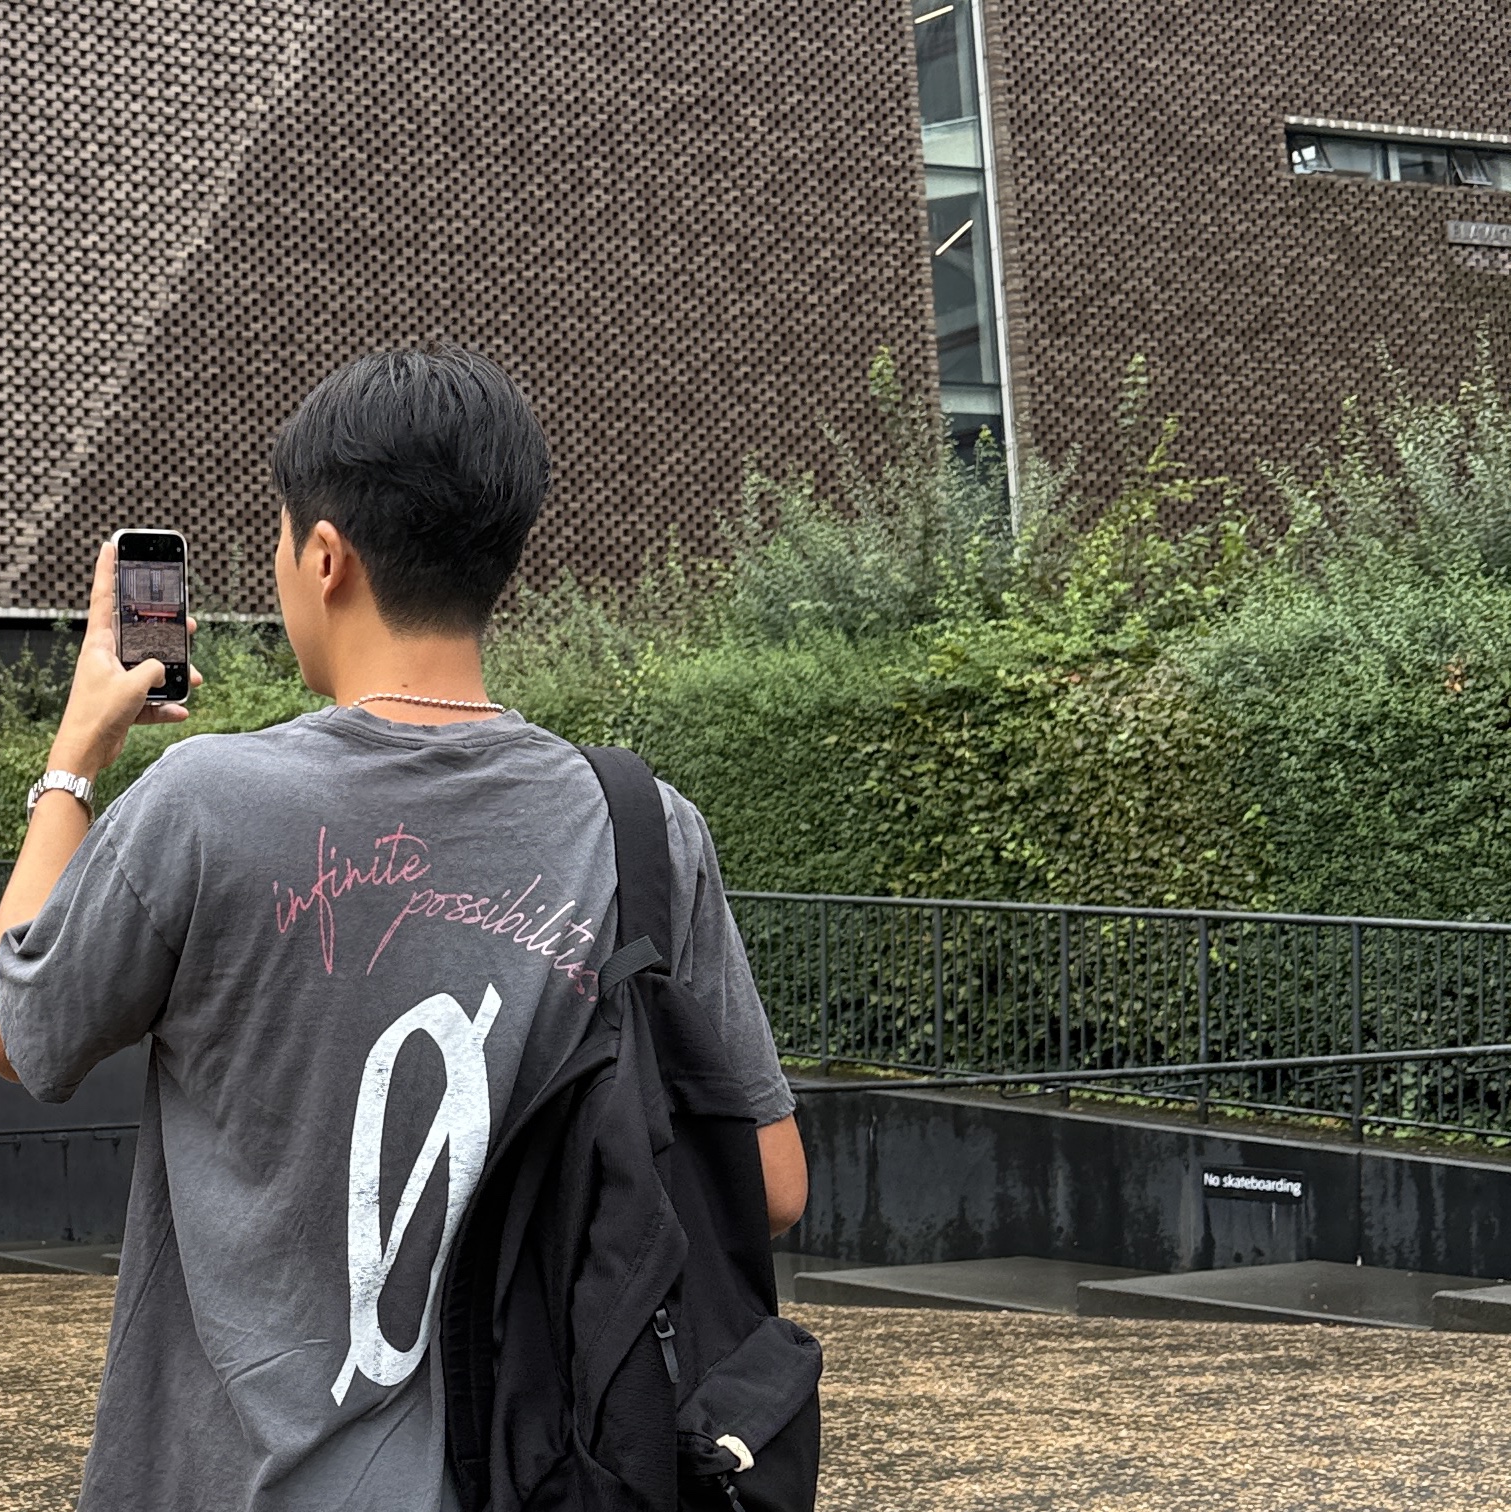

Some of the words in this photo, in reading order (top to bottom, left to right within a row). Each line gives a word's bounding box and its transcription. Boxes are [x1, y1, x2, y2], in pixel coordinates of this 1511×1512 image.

[272, 822, 431, 975] infinite
[1203, 1172, 1220, 1187] No
[1222, 1173, 1302, 1198] skateboarding
